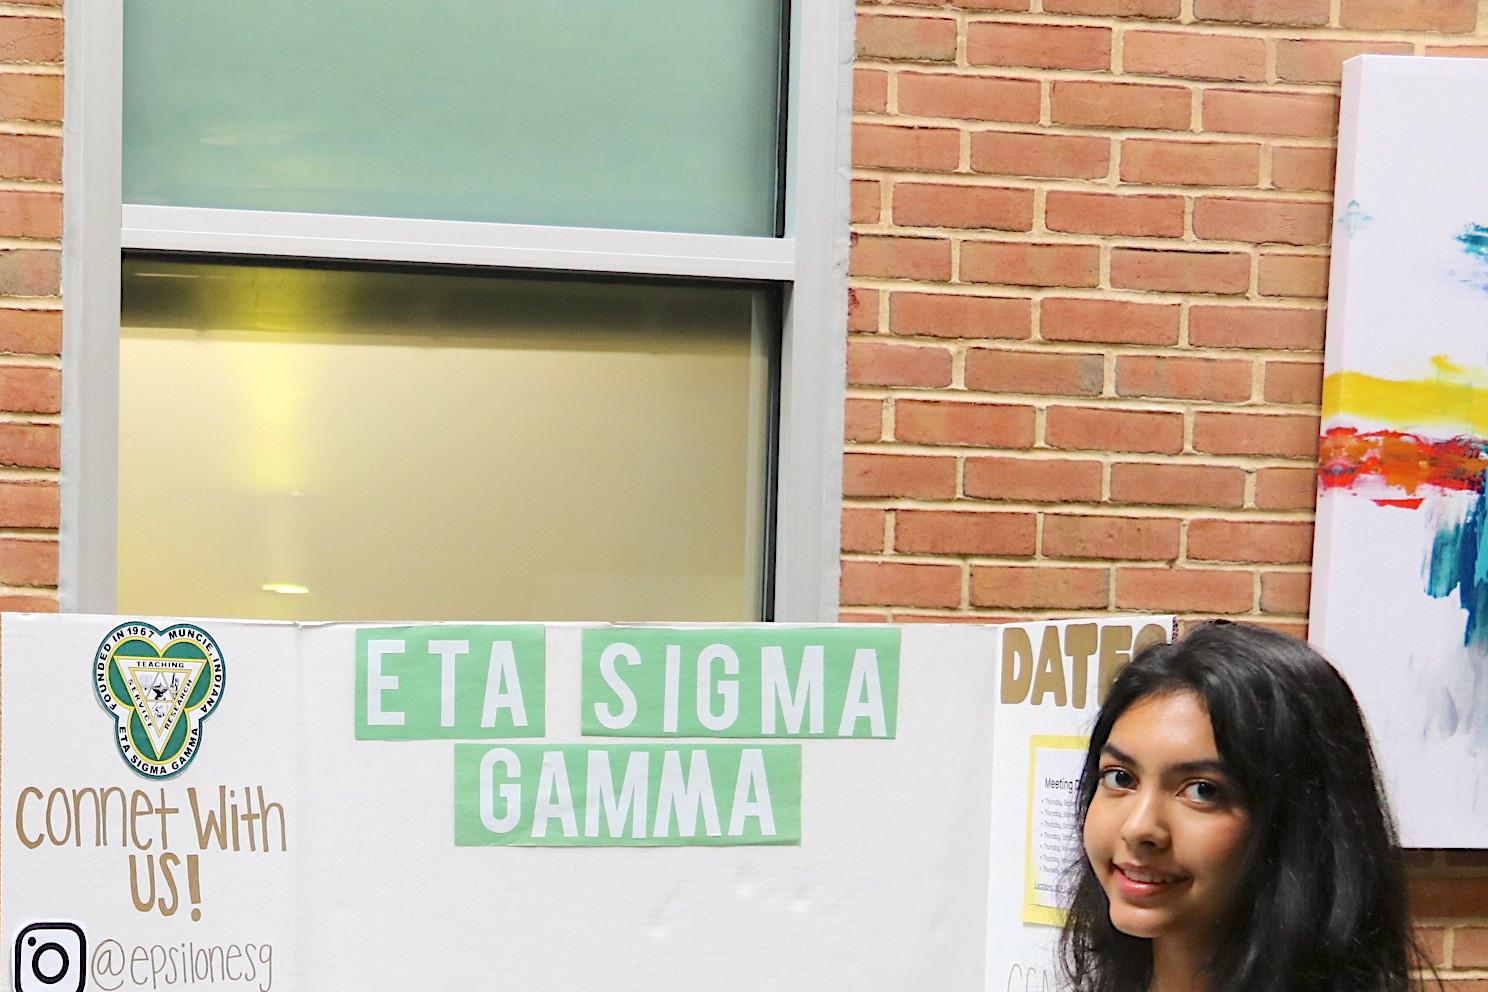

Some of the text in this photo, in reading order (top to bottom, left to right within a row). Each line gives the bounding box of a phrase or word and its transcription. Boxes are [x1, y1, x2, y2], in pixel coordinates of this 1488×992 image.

[98, 626, 154, 710] FOUNDED IN 1967
[168, 630, 221, 713] MUNCIE, INDIANA
[366, 639, 887, 737] ETA SIGMA
[128, 679, 152, 728] SERVICE
[164, 679, 192, 729] RESEARCH
[119, 727, 198, 775] ETA SIGMA GAMMA
[478, 747, 777, 839] GAMMA
[1045, 777, 1073, 793] Meeting
[91, 938, 272, 992] @epsilonesg
